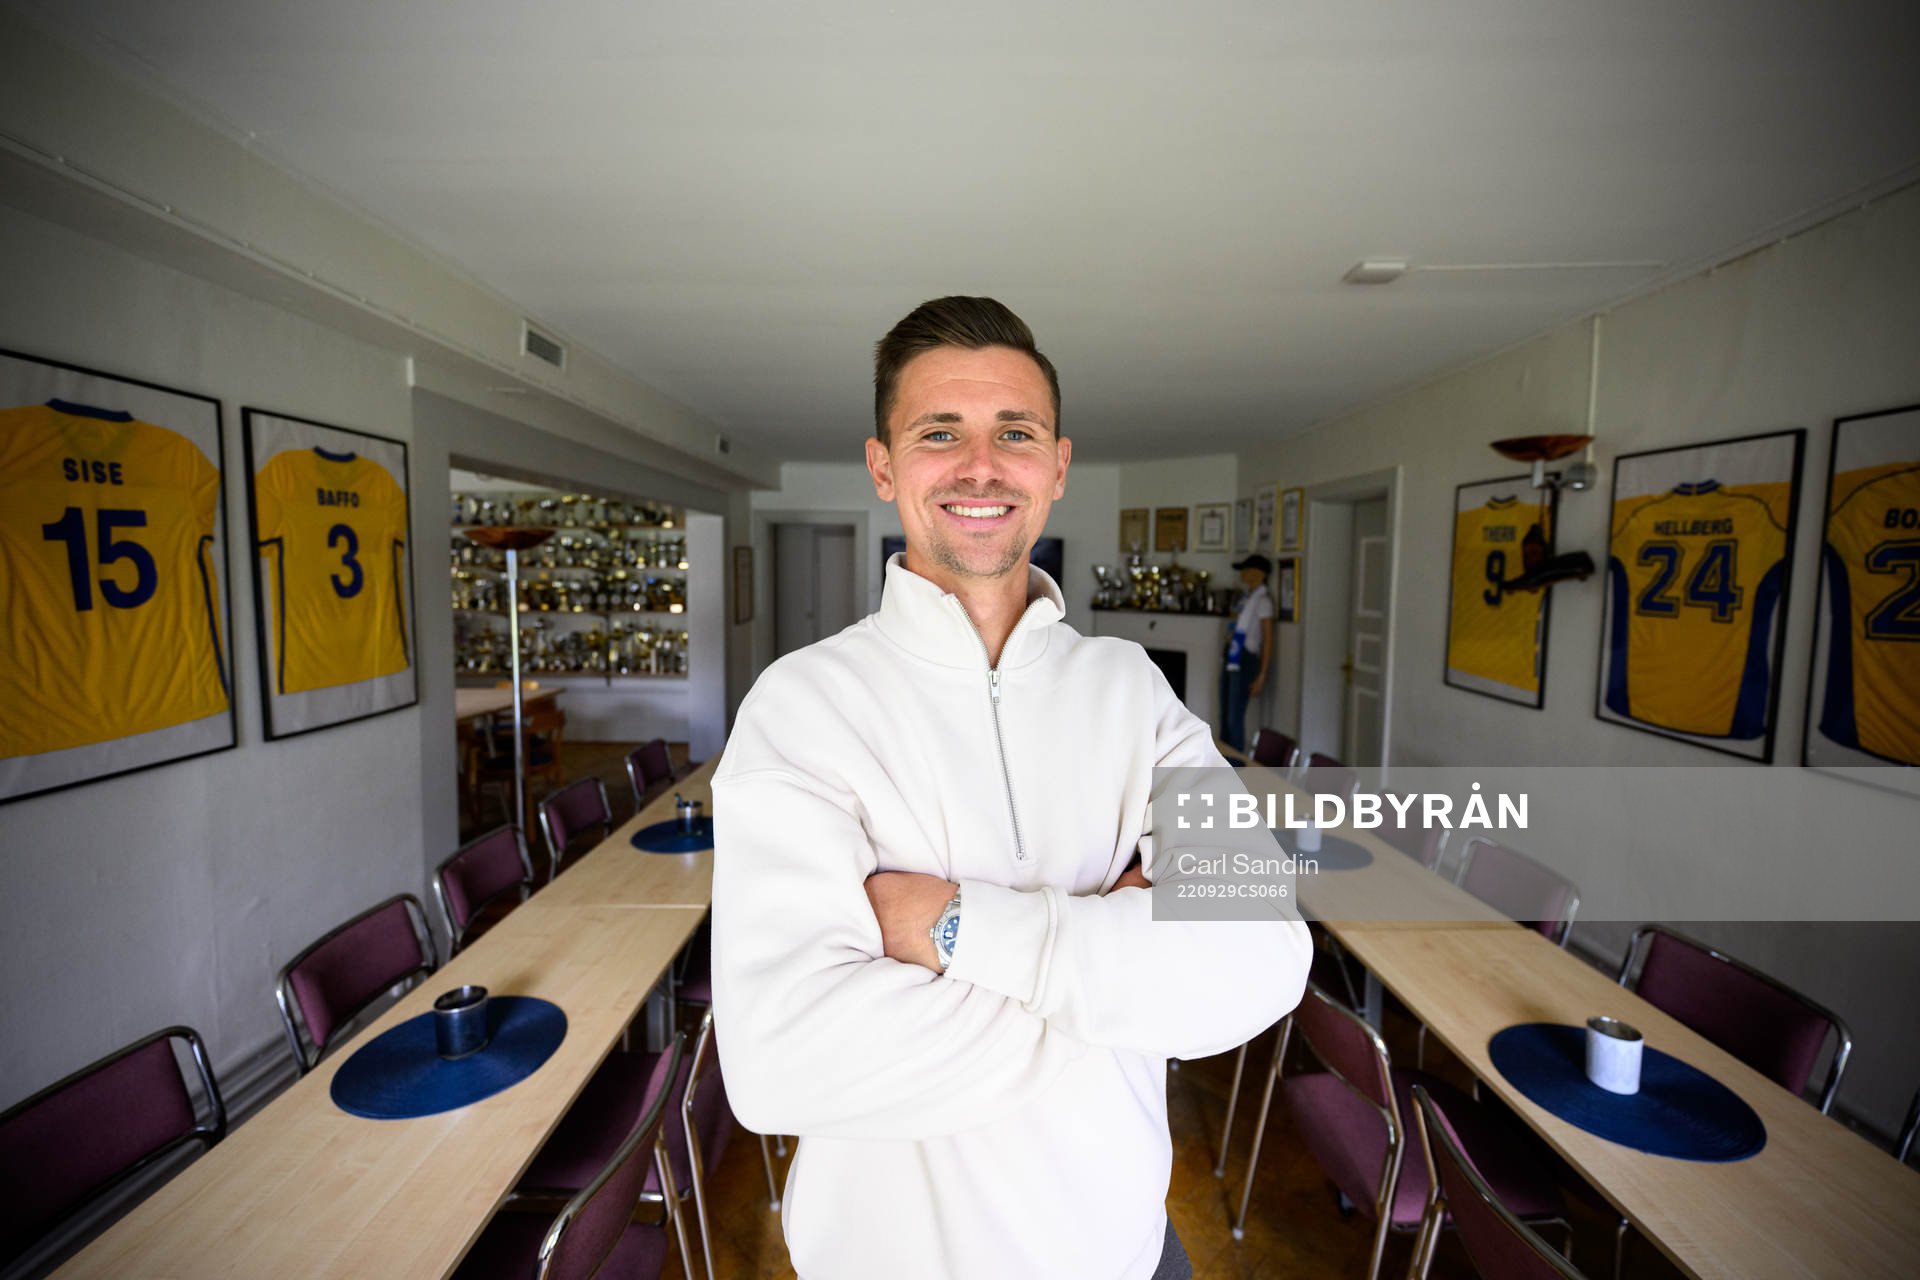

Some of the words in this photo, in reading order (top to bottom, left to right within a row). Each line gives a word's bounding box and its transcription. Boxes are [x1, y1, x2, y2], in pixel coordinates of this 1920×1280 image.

[63, 458, 124, 486] SISE
[316, 488, 360, 508] BAFFO
[1884, 506, 1920, 530] BO
[1654, 517, 1734, 536] HELLBERG
[42, 506, 158, 612] 15
[327, 523, 364, 599] 3
[1483, 550, 1506, 607] 9
[1635, 538, 1744, 624] 24
